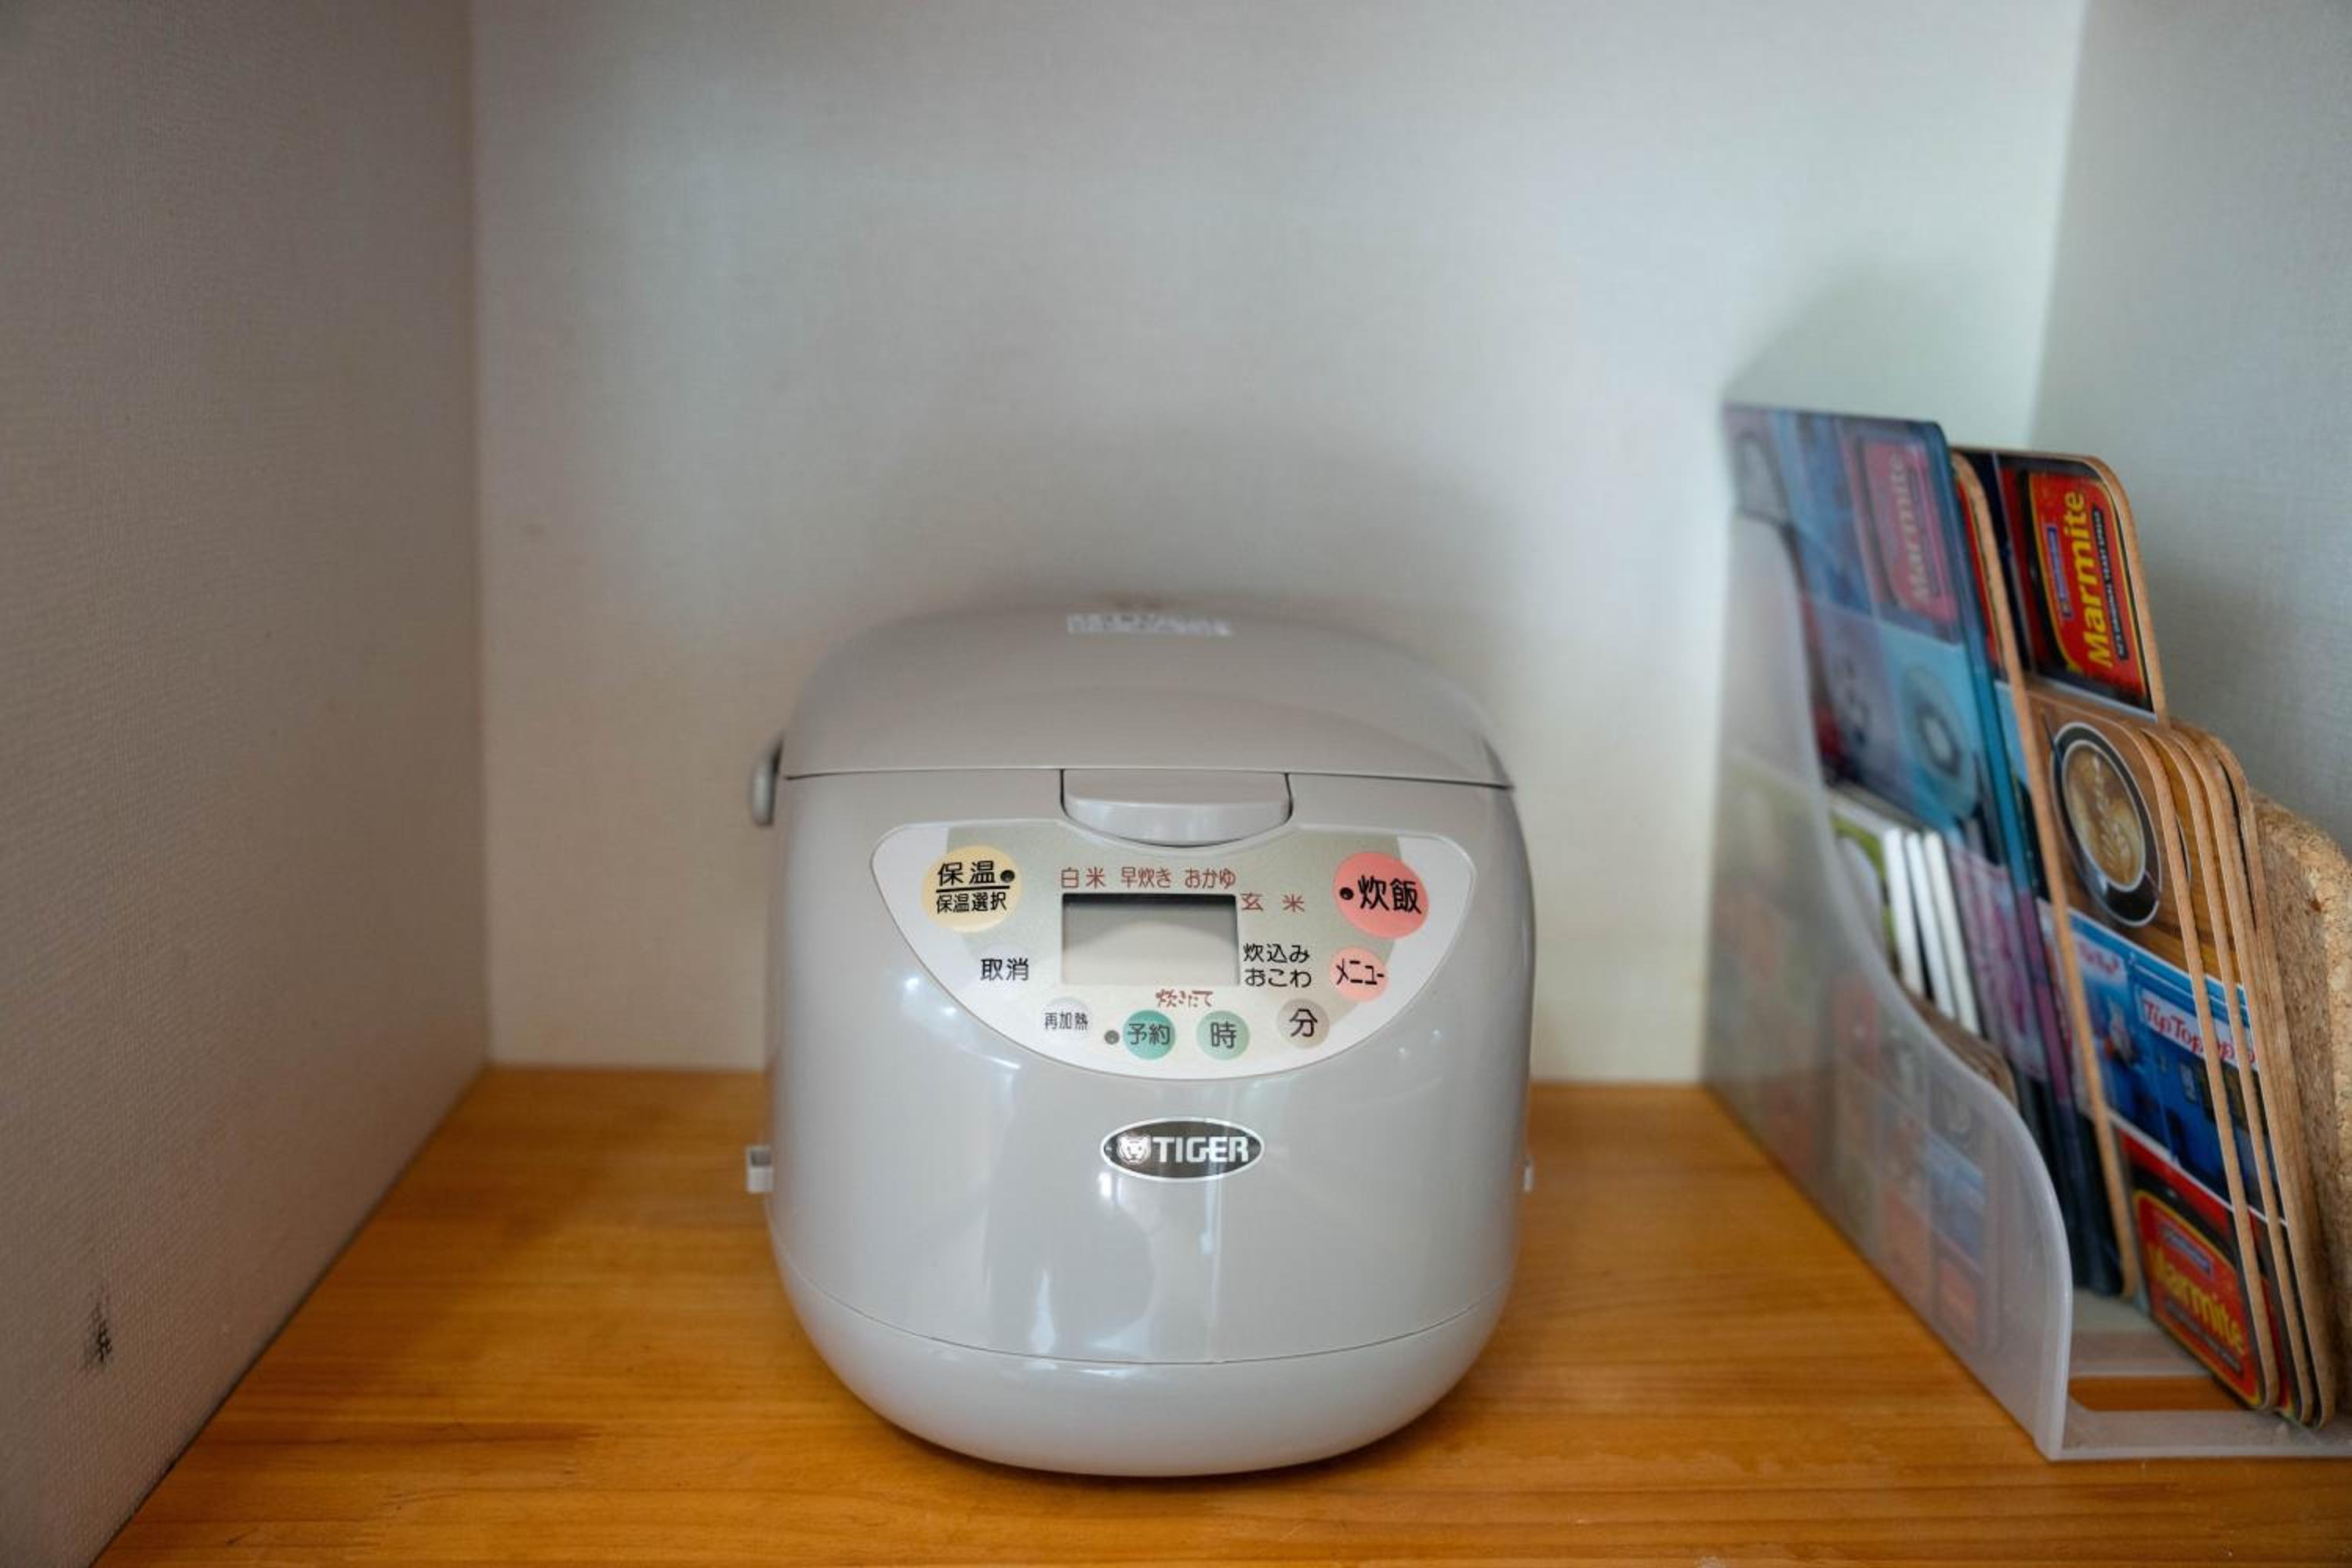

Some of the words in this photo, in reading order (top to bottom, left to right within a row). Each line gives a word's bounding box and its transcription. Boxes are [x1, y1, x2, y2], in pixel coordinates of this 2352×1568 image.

[2063, 491, 2113, 668] Marmite
[937, 860, 996, 886] 保温
[1061, 866, 1106, 888] 白米
[1120, 866, 1172, 888] 早炊き
[1185, 868, 1236, 889] おかゆ
[936, 891, 1007, 913] 保温選択
[1357, 875, 1422, 914] 炊飯
[1243, 943, 1310, 963] 炊込み
[981, 958, 1029, 981] 取消
[1245, 968, 1312, 988] おこわ
[1336, 958, 1385, 985] メニュー
[1044, 1012, 1088, 1031] 再加熱
[1289, 1007, 1319, 1037] 分
[1127, 1023, 1171, 1046] 予約
[1210, 1021, 1237, 1049] 時
[1152, 1136, 1249, 1163] TIGER
